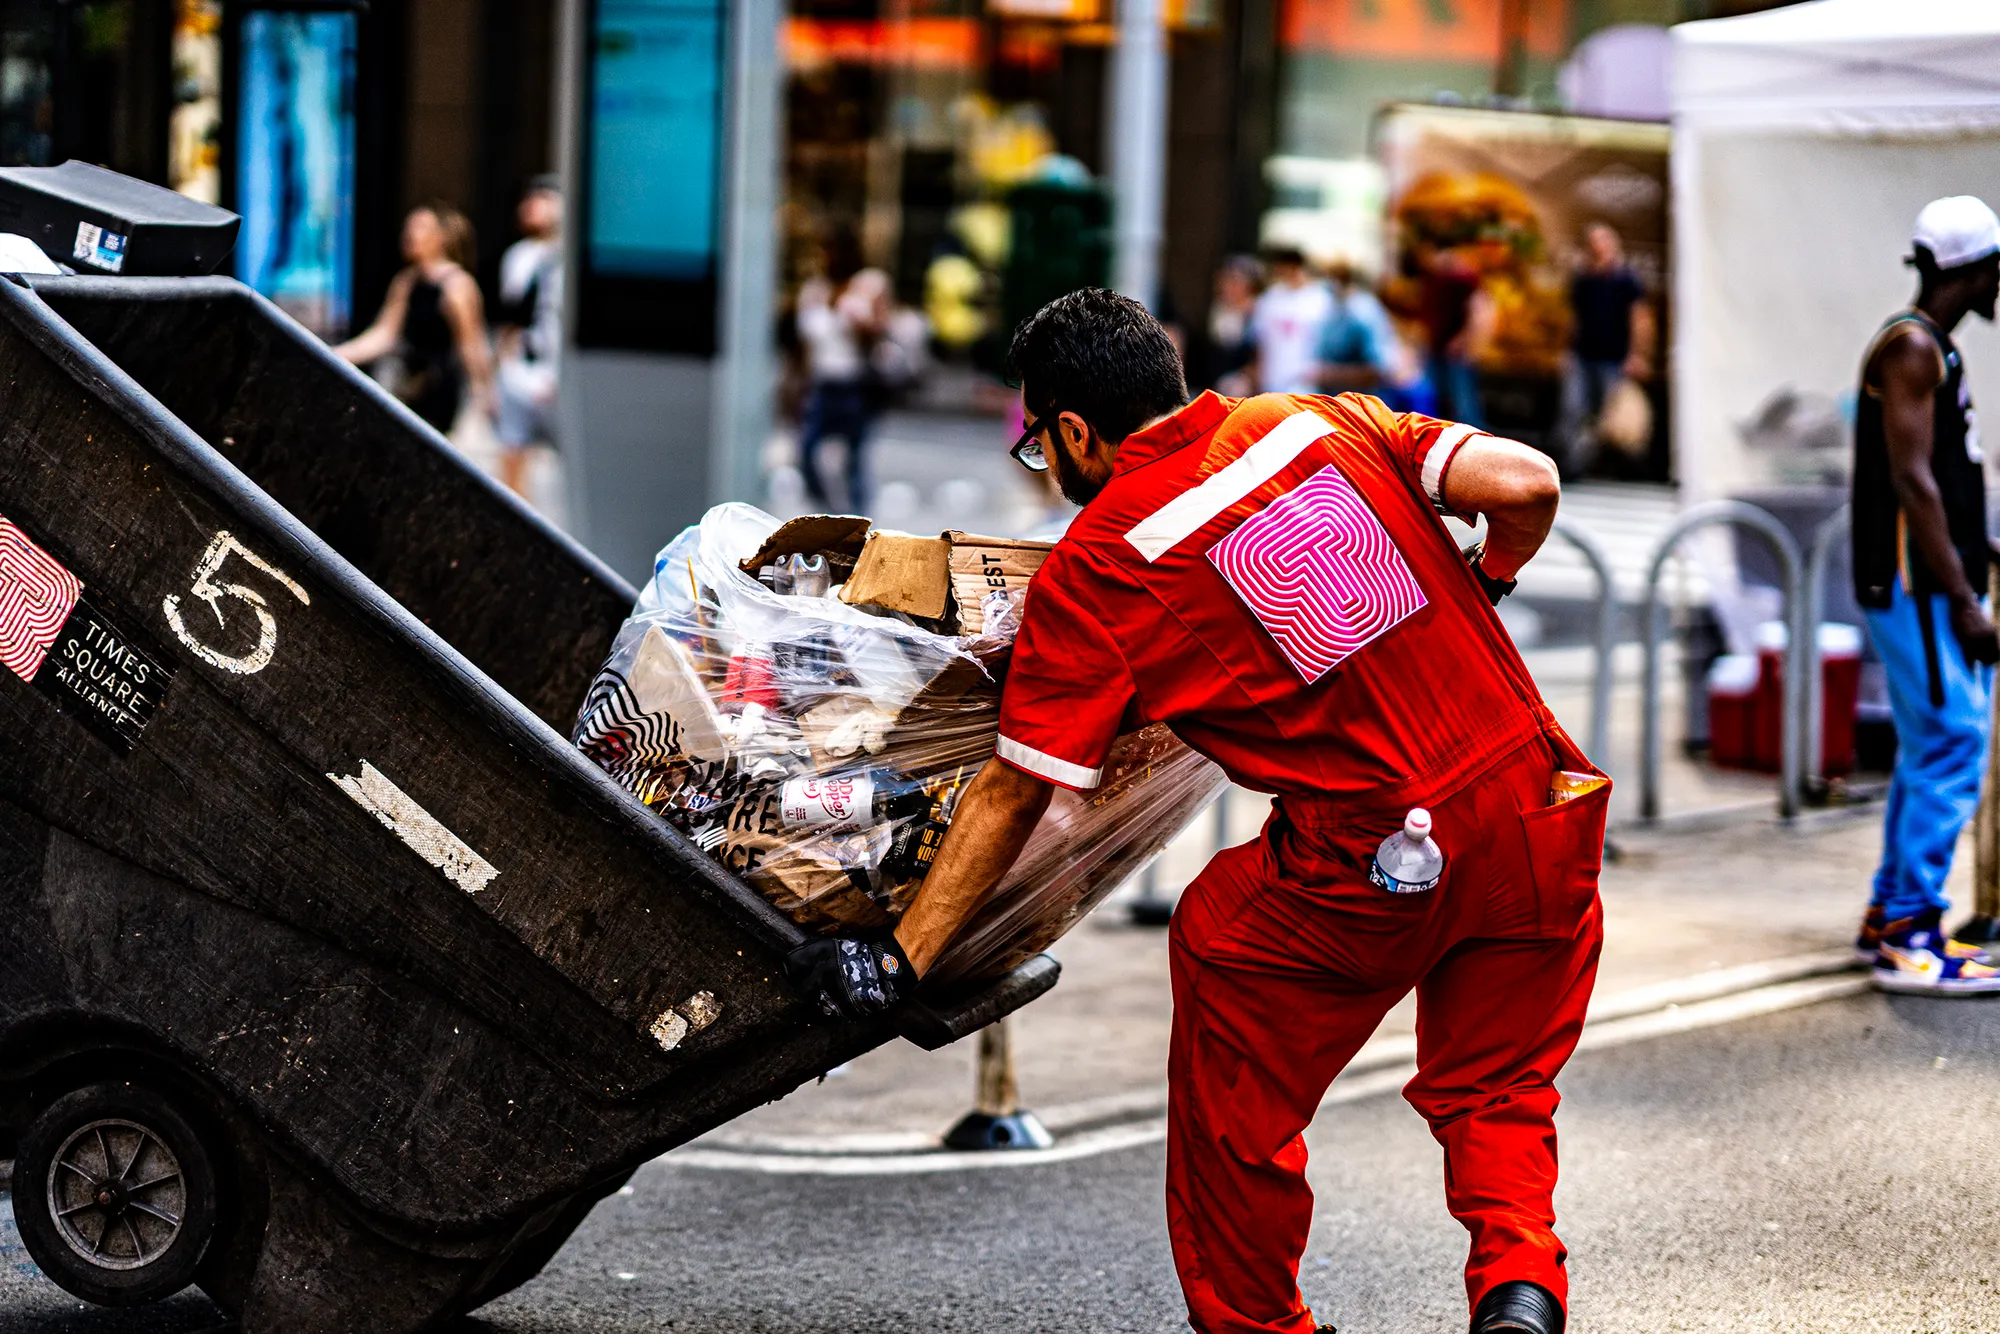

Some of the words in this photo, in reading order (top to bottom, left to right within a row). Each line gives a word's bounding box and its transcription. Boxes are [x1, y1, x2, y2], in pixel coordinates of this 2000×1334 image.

[163, 530, 310, 675] 5
[63, 639, 147, 714] SQUARE
[86, 620, 150, 684] TIMES
[824, 780, 846, 816] epper
